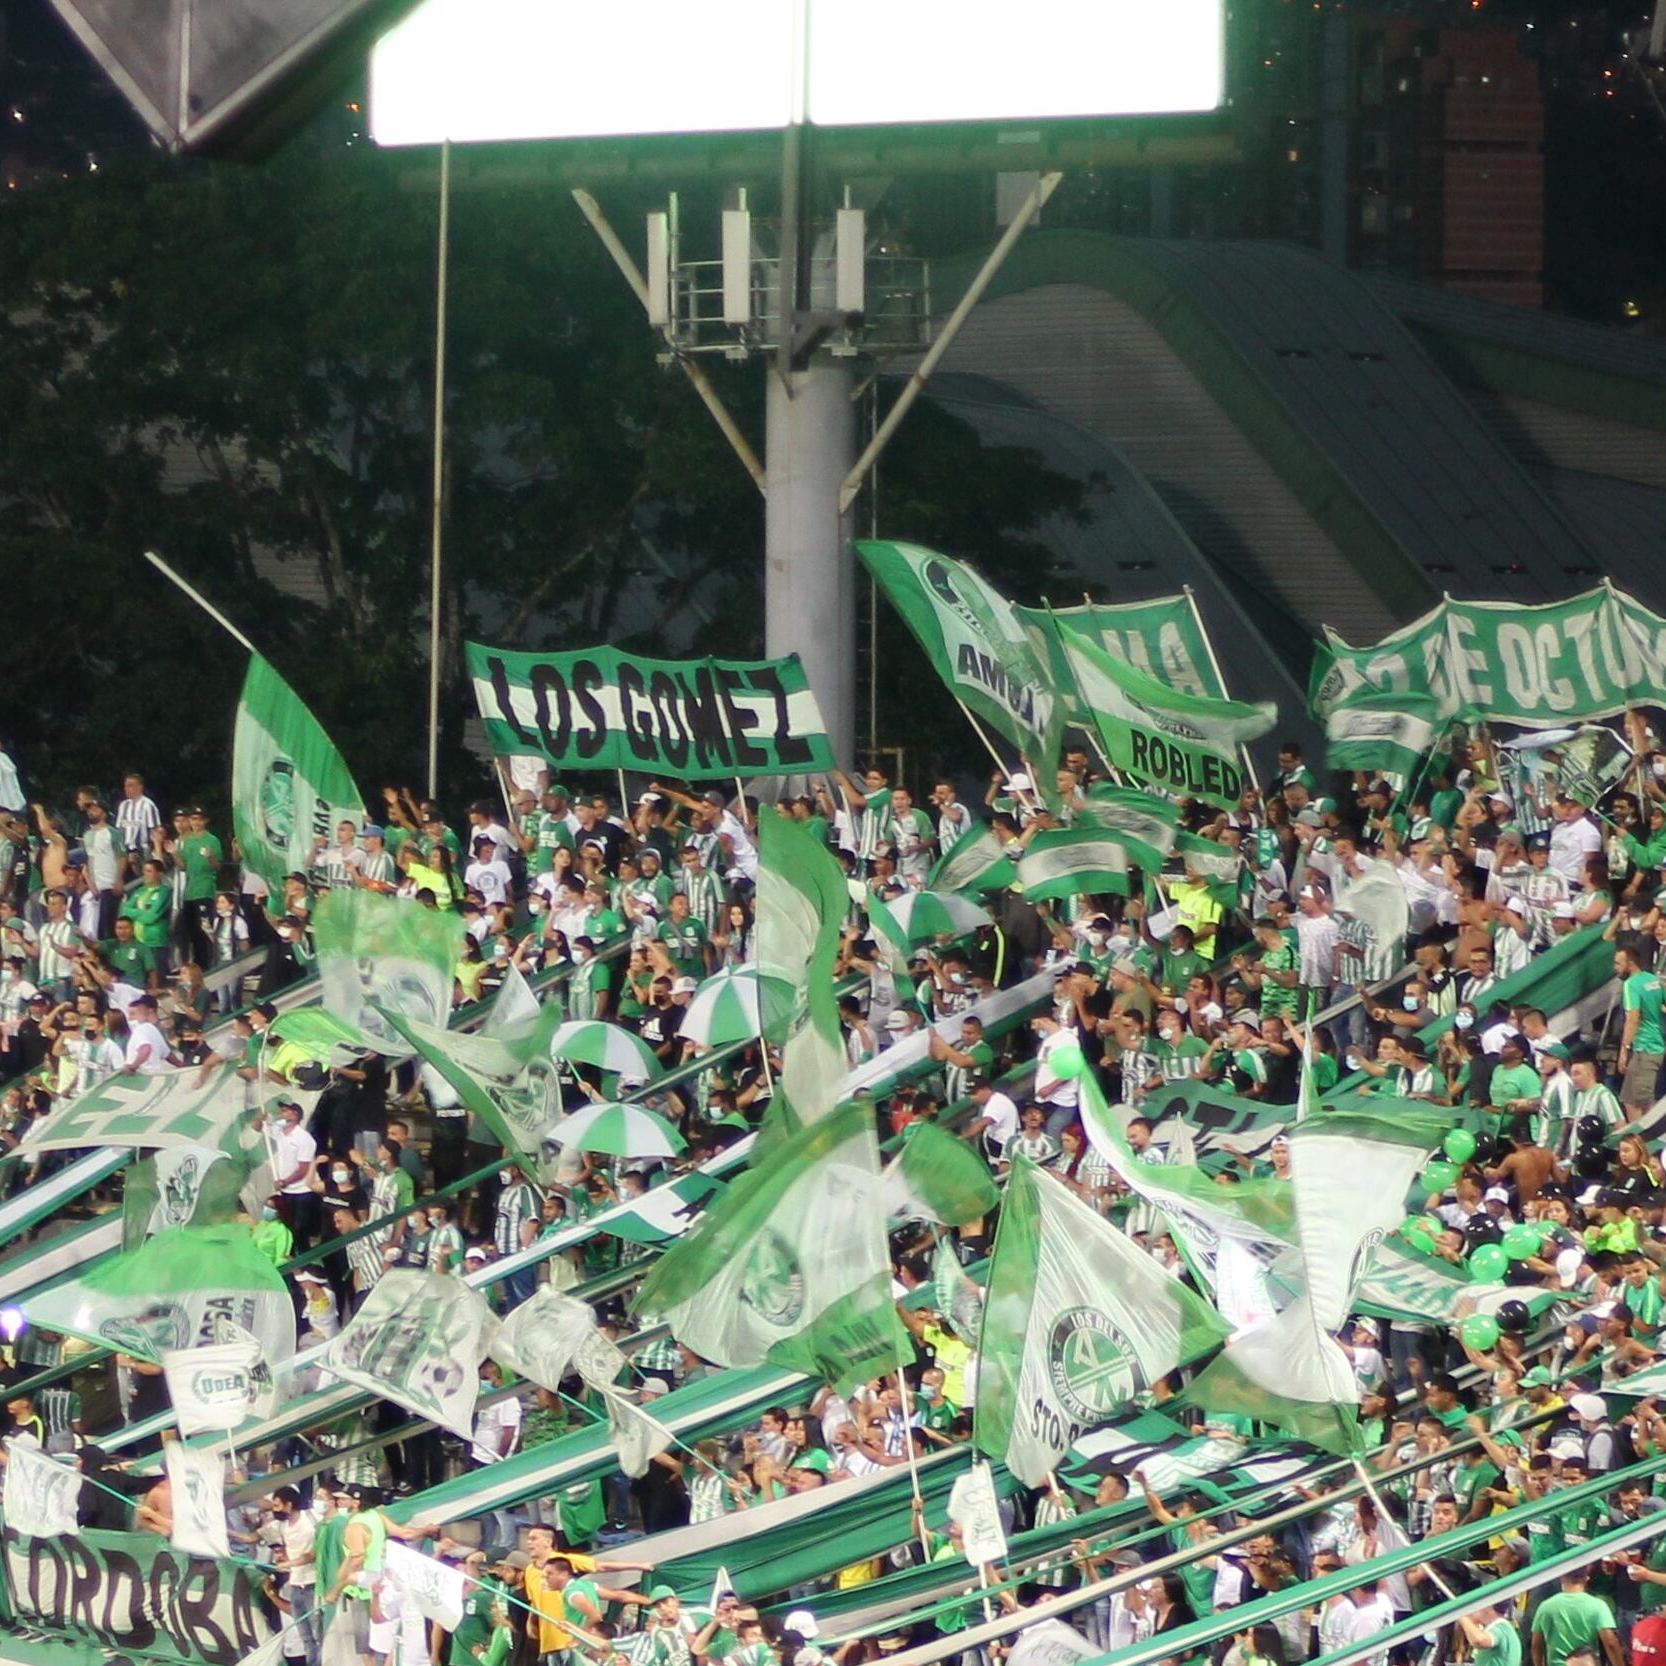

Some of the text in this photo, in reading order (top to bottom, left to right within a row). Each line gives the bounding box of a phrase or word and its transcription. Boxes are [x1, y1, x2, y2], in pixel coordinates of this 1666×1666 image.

[486, 655, 815, 771] LOS GOMEZ
[1129, 727, 1244, 802] ROBLED
